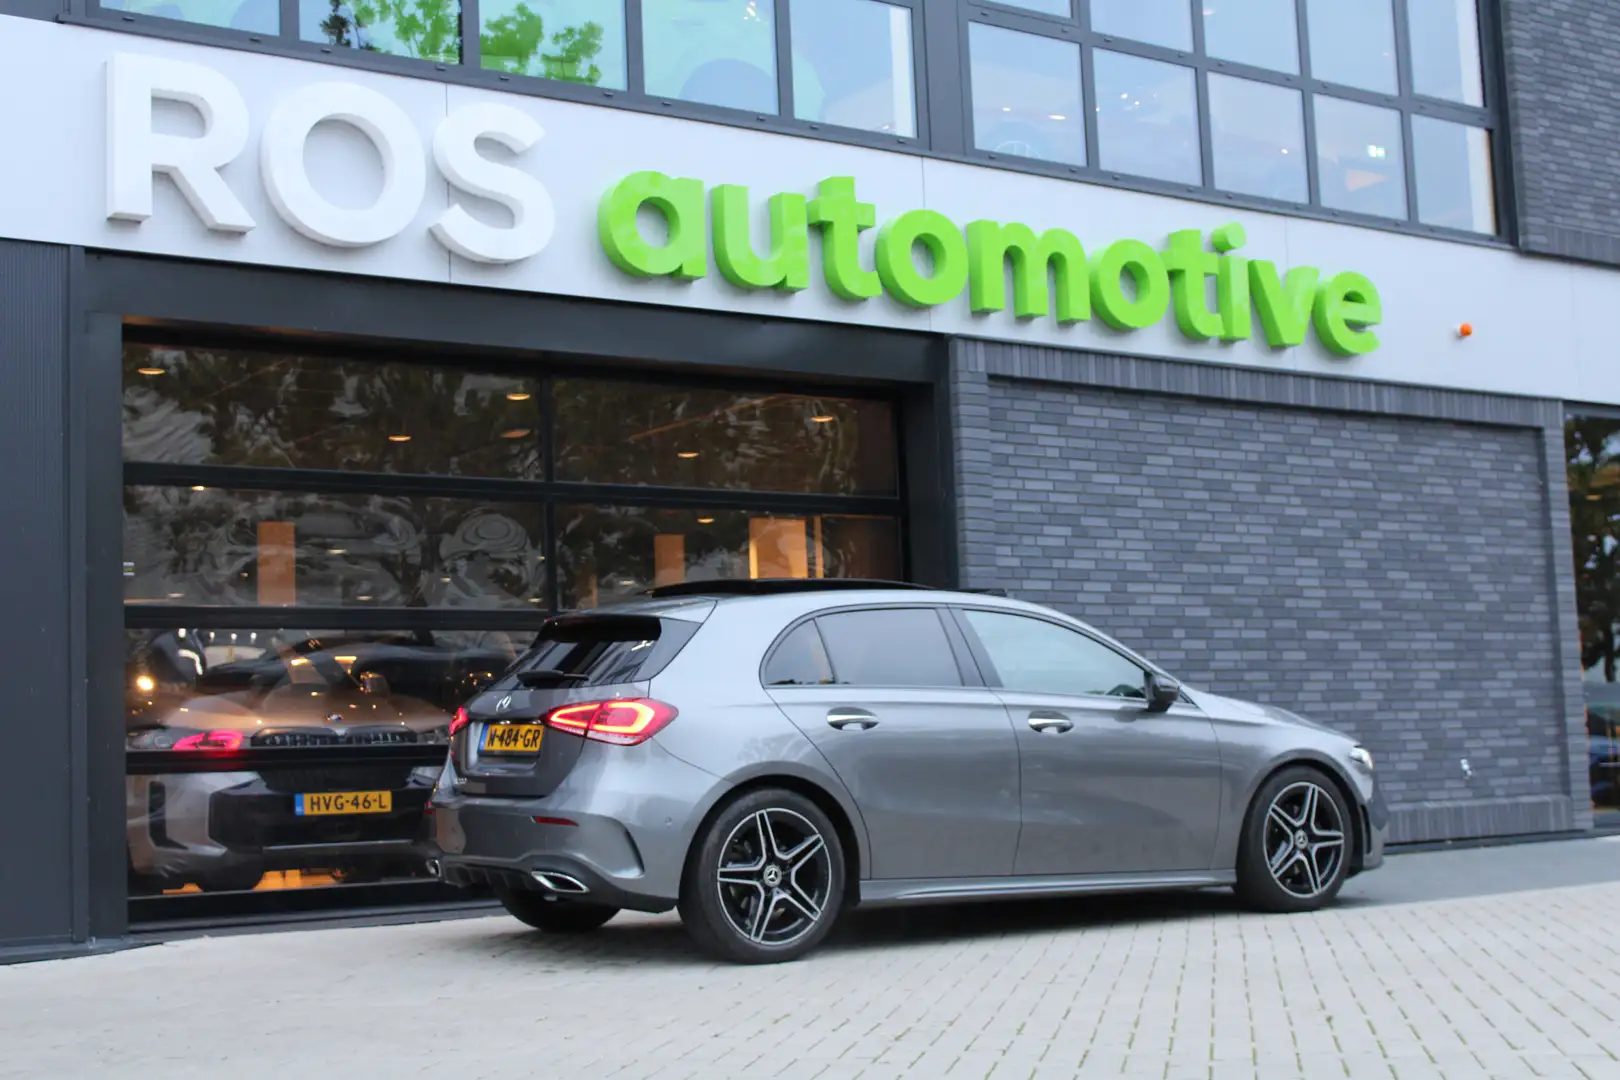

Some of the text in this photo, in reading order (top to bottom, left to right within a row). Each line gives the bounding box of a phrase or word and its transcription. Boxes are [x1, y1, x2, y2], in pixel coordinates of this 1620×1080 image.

[104, 52, 1382, 357] ROS automotive
[487, 728, 541, 748] N-484-GR
[310, 792, 388, 812] HVG-46-L
